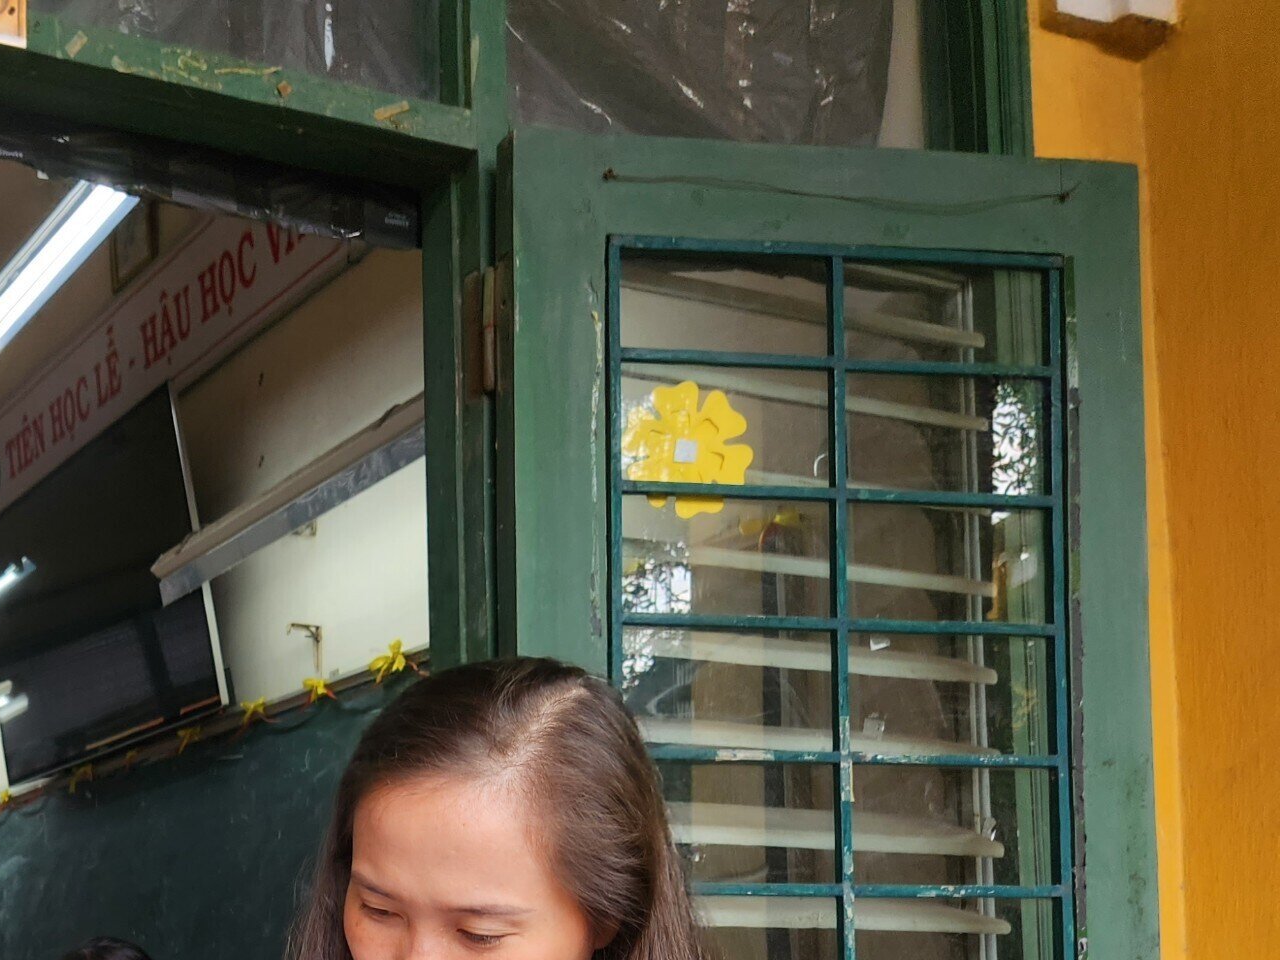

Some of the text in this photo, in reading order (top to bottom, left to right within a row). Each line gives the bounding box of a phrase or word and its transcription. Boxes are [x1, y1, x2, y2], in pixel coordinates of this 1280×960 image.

[5, 414, 46, 479] TIÊN
[49, 375, 90, 442] HỌC
[140, 285, 191, 370] HẬU
[198, 229, 258, 324] HỌC
